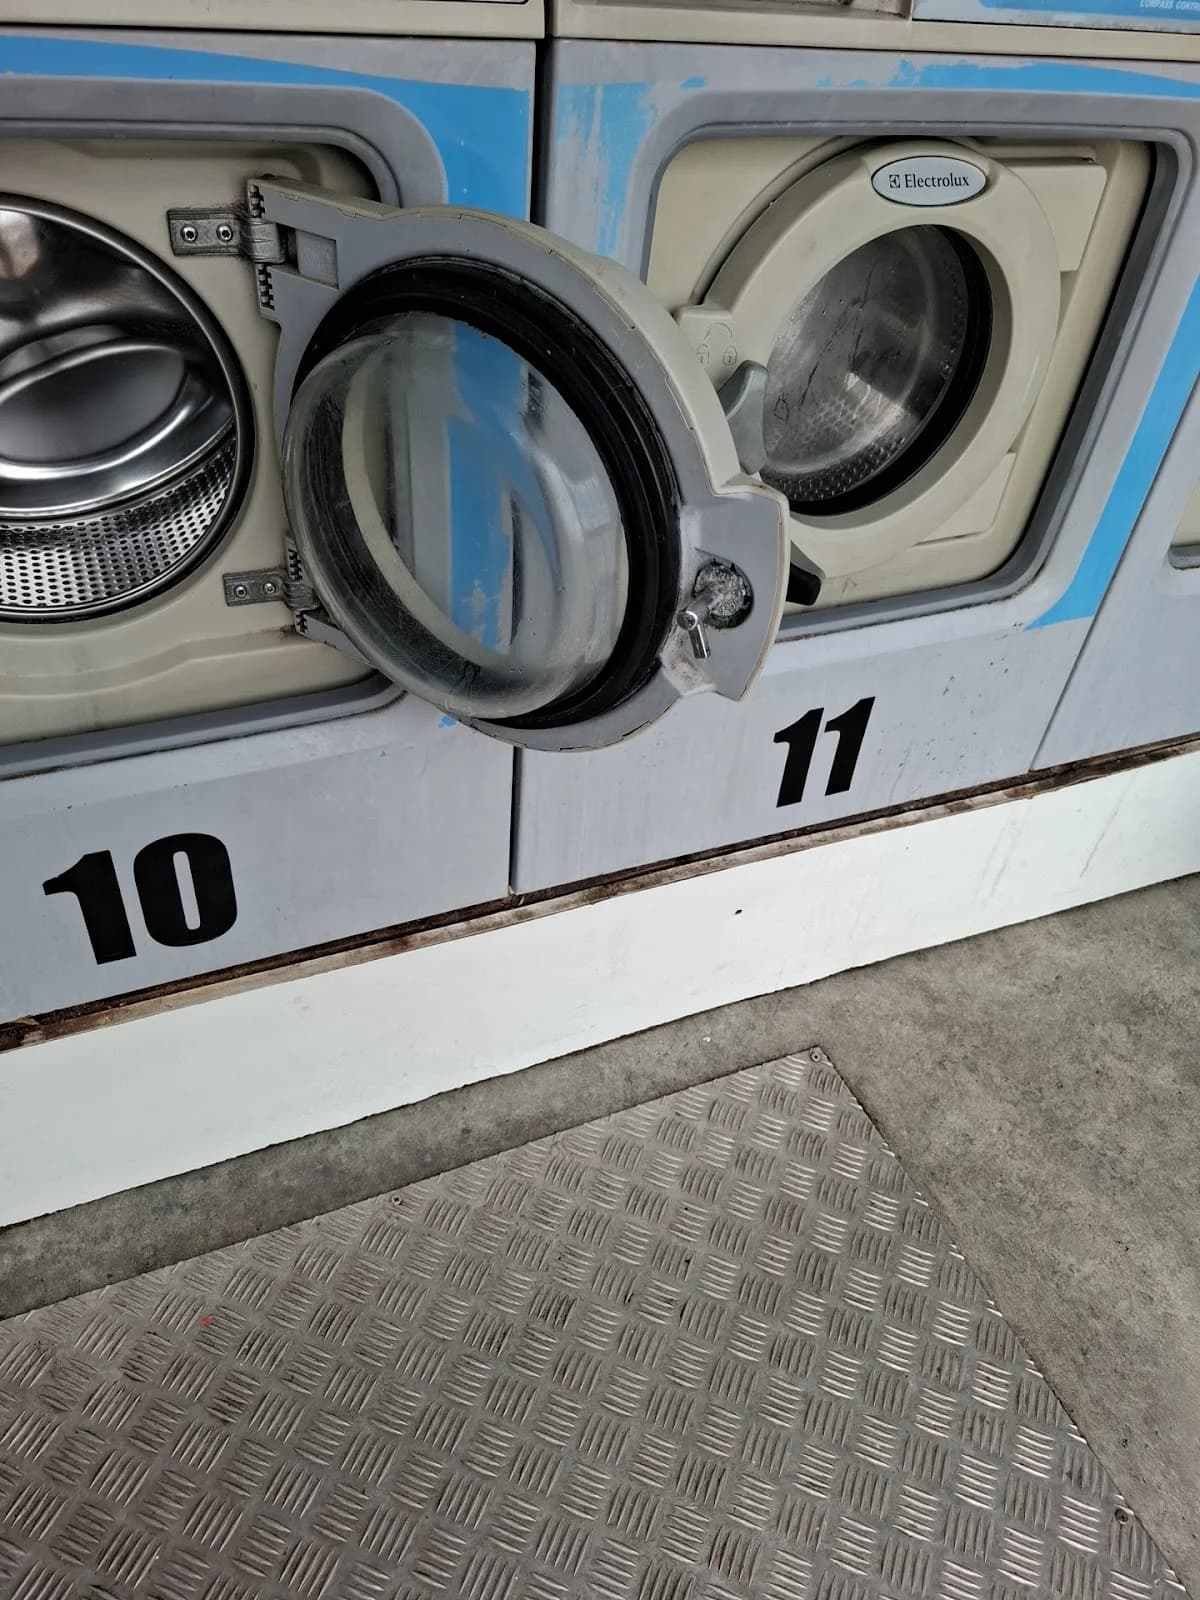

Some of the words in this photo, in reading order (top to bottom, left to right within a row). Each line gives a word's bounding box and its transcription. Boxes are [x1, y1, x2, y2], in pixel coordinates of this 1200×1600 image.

[904, 173, 970, 188] Electrolux
[773, 696, 876, 808] 11
[42, 832, 238, 965] 10
